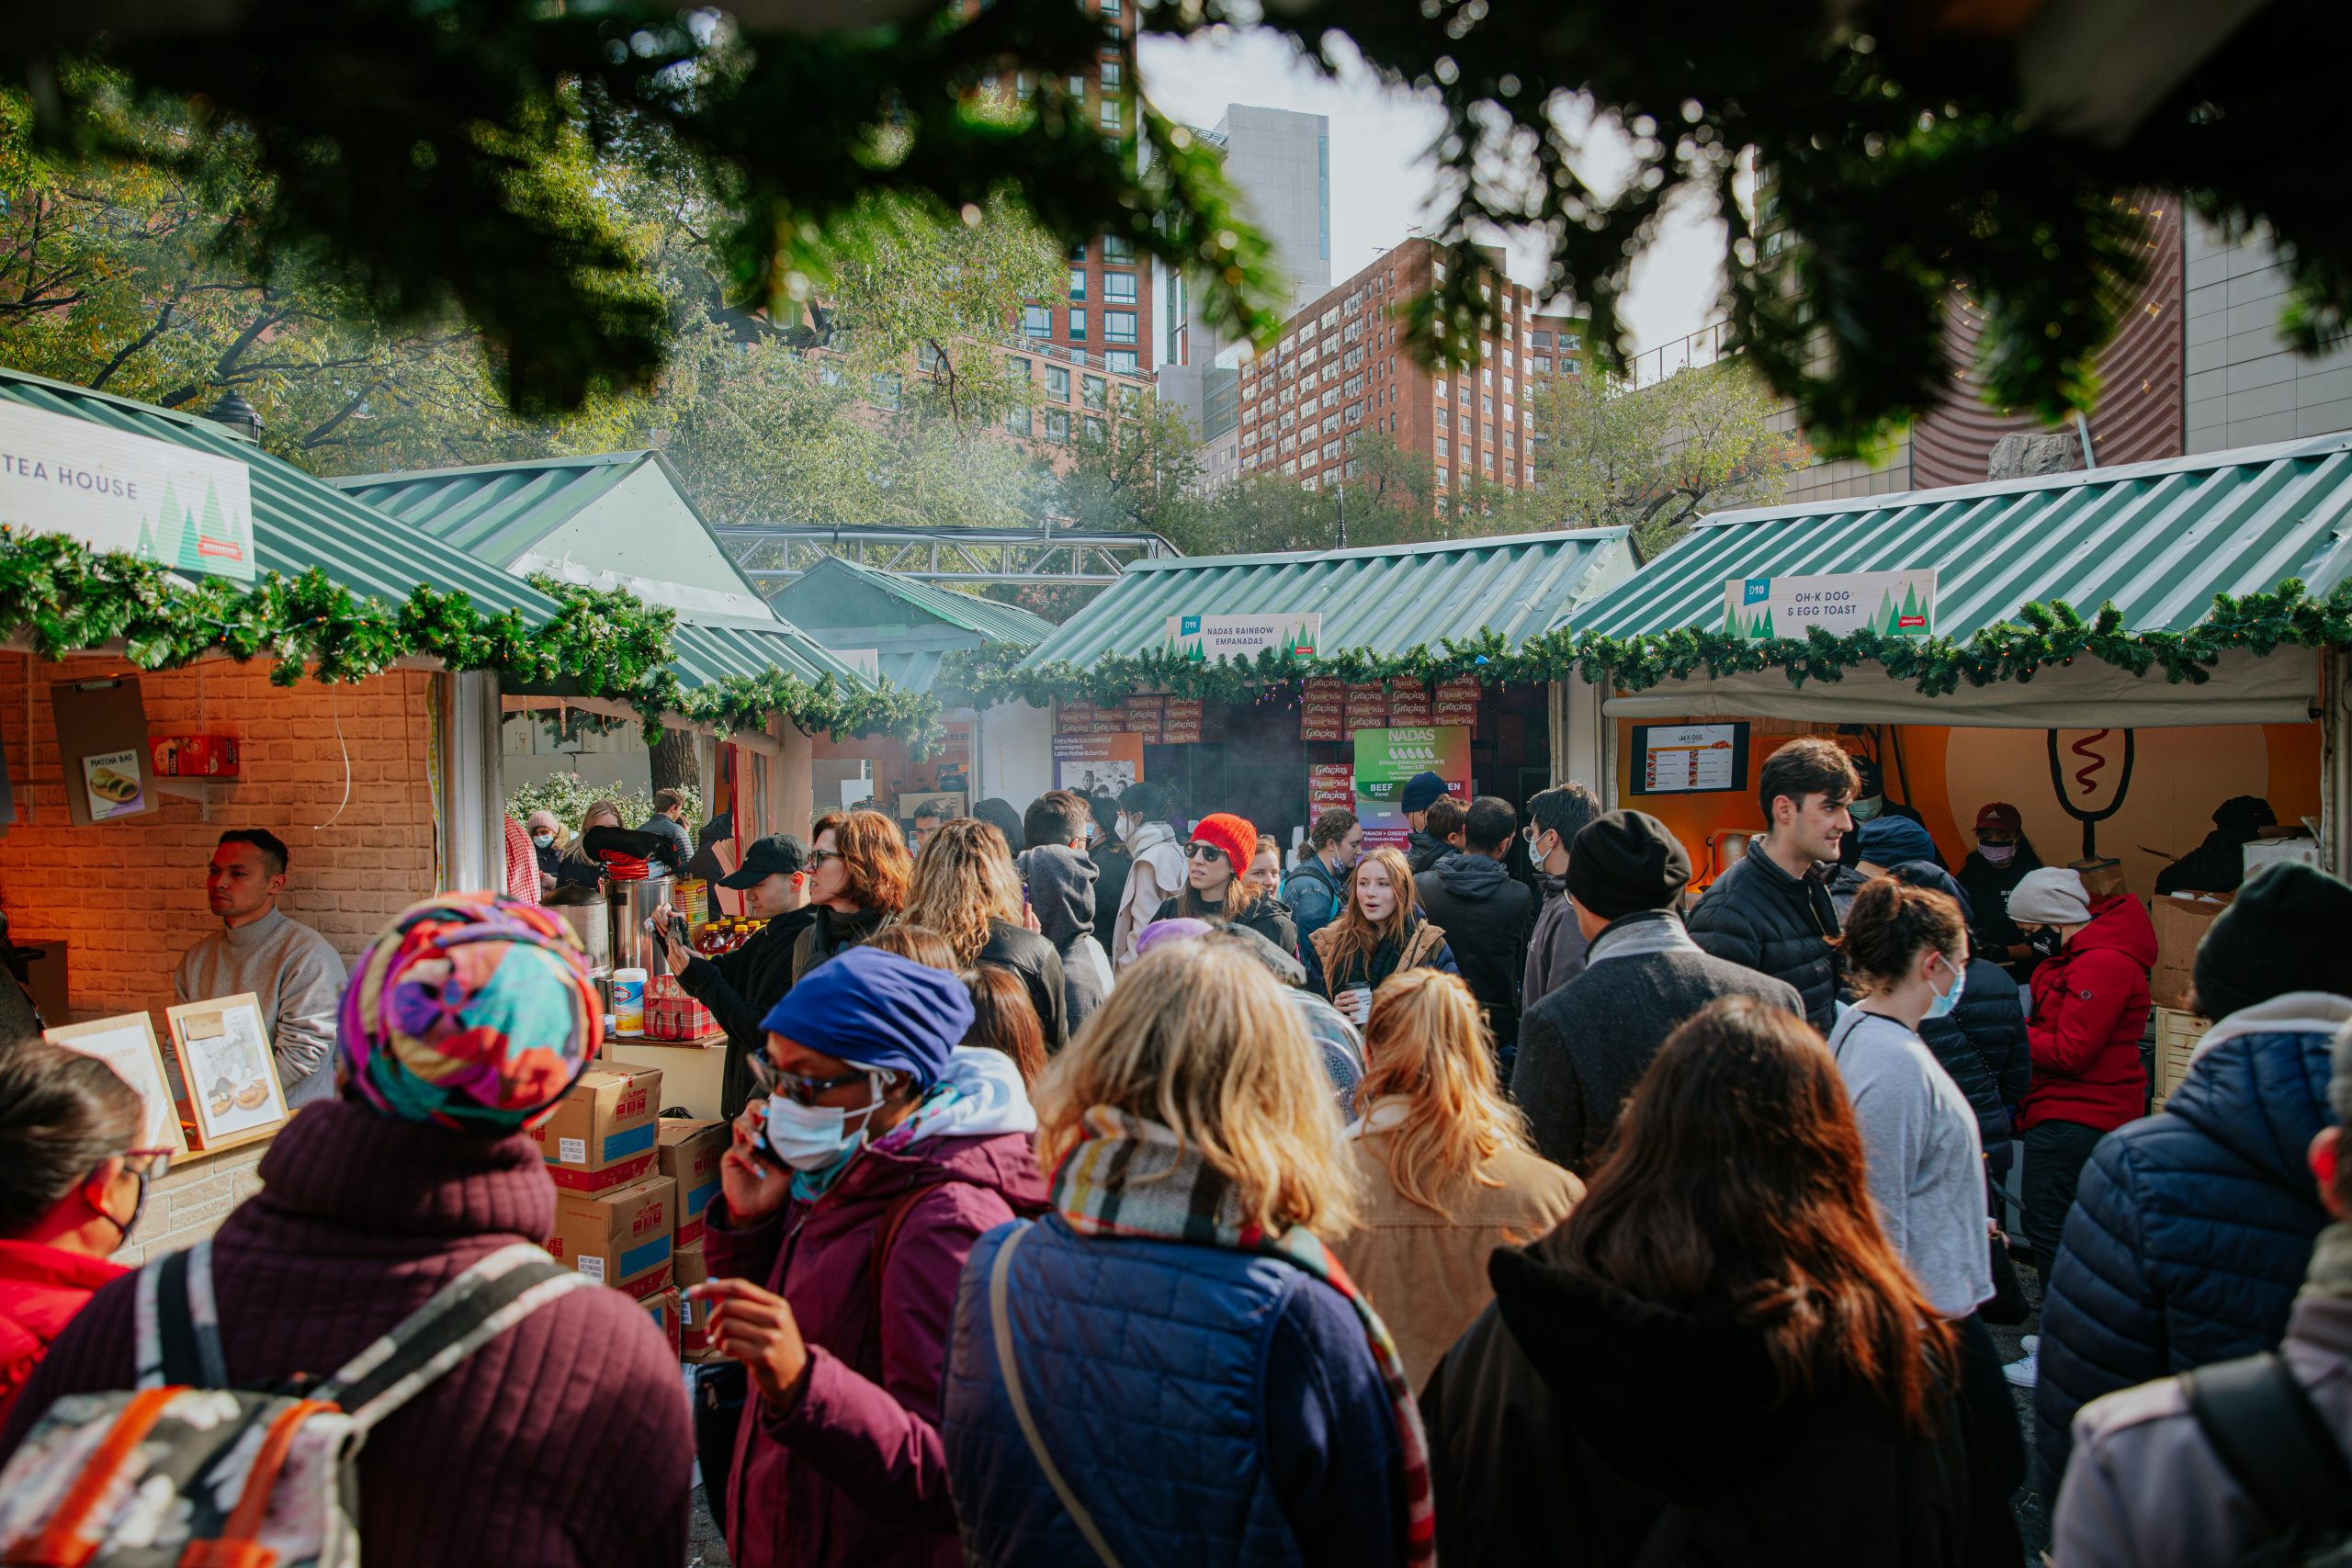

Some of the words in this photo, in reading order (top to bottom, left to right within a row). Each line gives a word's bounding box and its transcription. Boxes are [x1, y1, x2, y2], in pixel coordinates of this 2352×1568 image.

[3, 454, 49, 481] TEA
[59, 467, 139, 501] HOUSE
[1748, 585, 1765, 595] D10
[1795, 592, 1822, 603] OH-K
[1825, 591, 1850, 602] DOG
[1787, 607, 1793, 616] &
[1797, 606, 1820, 616] EGG
[1824, 604, 1857, 615] TOAST
[1207, 626, 1234, 636] NADAS
[1235, 626, 1274, 635] RAINBOW
[1216, 637, 1264, 646] EMPANADAS
[1308, 678, 1341, 689] Gracias
[1306, 692, 1329, 701] Thank
[1329, 692, 1341, 700] You
[1350, 691, 1382, 702] Gracias
[1392, 690, 1426, 701] Gracias
[1437, 690, 1464, 699] Thank
[1128, 699, 1148, 707] Thank
[1149, 698, 1160, 706] You
[1438, 701, 1472, 713] Gracias
[1165, 709, 1188, 717] Thank
[1306, 703, 1339, 714] Gracias
[1347, 705, 1372, 715] Thank
[1393, 703, 1426, 715] Gracias
[1129, 710, 1157, 720] Gracias
[1169, 719, 1197, 730] Gracias
[1303, 717, 1327, 727] Thank
[1327, 717, 1339, 726] You
[1349, 716, 1382, 728] Gracias
[1390, 718, 1416, 728] Thank
[1434, 716, 1461, 726] Thank
[1062, 723, 1089, 734] Gracias
[1094, 722, 1120, 733] Gracias
[1163, 734, 1185, 742] Thank
[1306, 728, 1338, 739] Gracias
[1388, 729, 1435, 742] NADAS
[90, 756, 118, 768] MATCHA
[119, 753, 133, 762] BAO
[1315, 765, 1348, 775] Gracias
[1310, 779, 1336, 788] Thank
[1370, 784, 1394, 792] BEEF
[1314, 790, 1347, 801] Gracias
